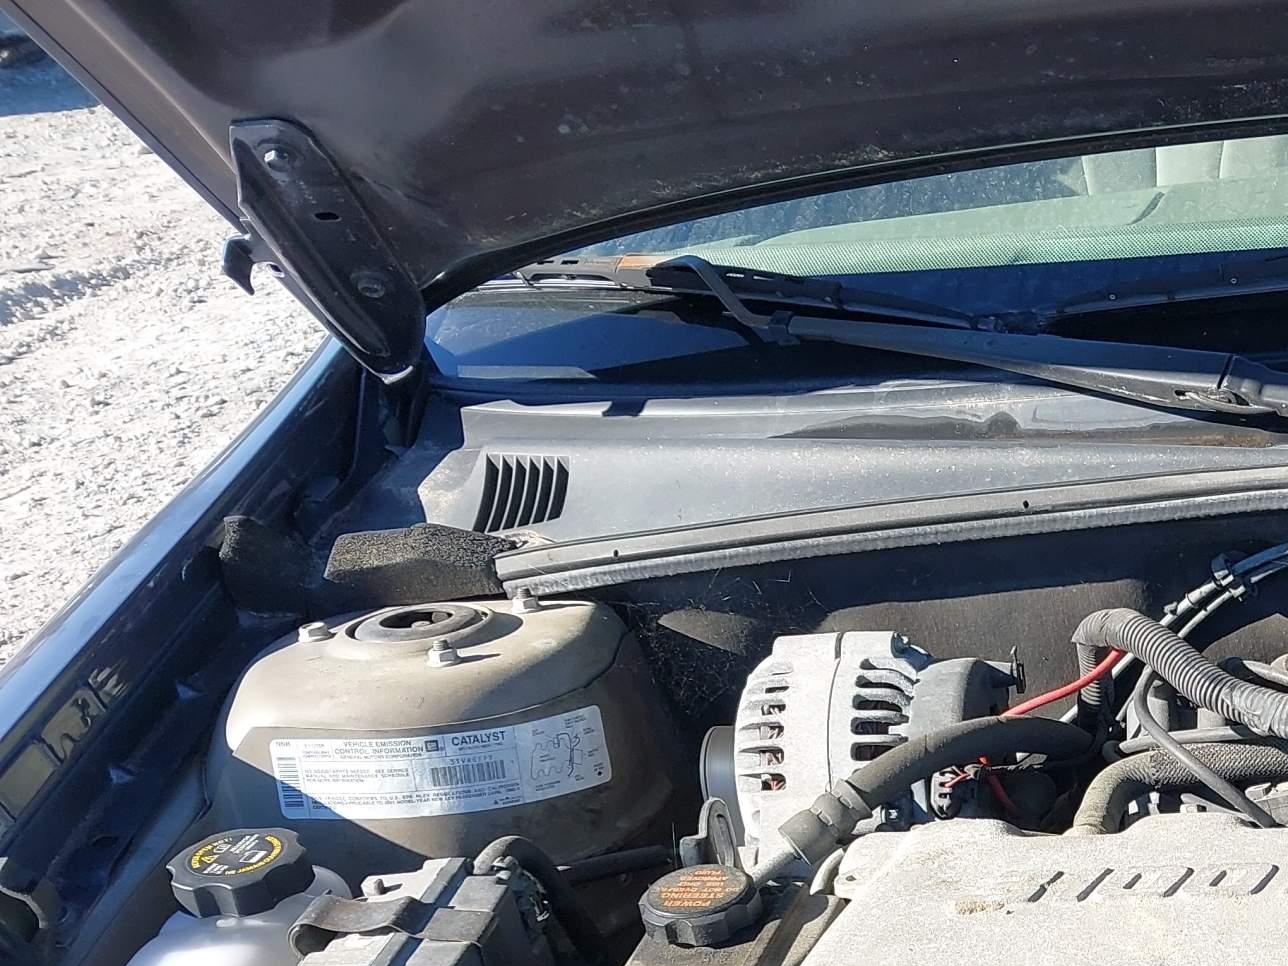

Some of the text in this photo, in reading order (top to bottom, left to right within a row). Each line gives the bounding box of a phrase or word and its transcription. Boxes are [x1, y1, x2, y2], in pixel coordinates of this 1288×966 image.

[451, 730, 506, 746] CATALYST
[343, 739, 412, 748] VEHICLE EMISSION
[334, 747, 370, 755] CONTROL
[372, 746, 424, 754] INFORMATION
[661, 891, 724, 899] STEERING
[663, 900, 712, 908] POWER
